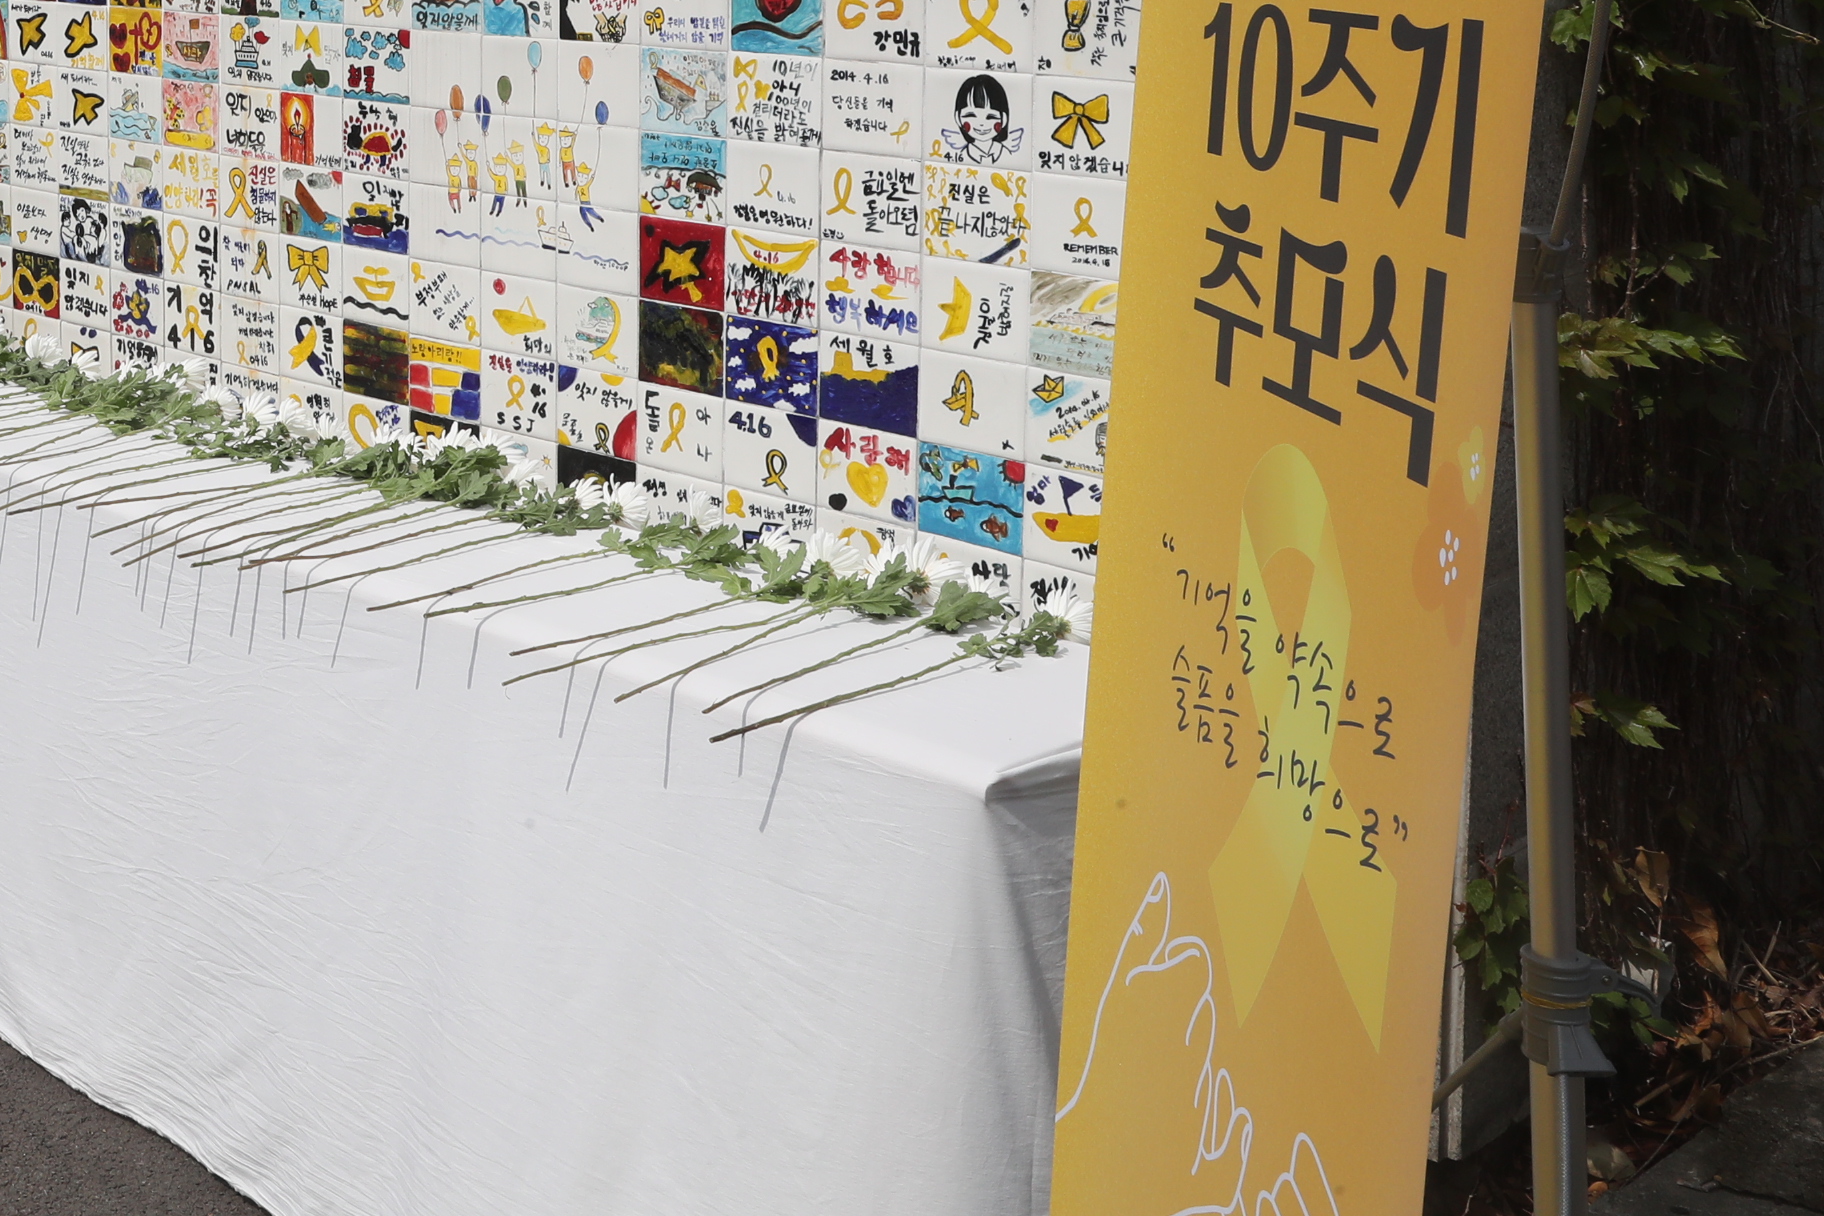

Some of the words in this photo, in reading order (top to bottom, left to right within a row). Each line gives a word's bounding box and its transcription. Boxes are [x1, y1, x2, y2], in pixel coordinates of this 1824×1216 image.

[873, 28, 921, 58] 강민규
[772, 80, 802, 96] 아니
[225, 92, 252, 117] 잊지
[831, 94, 869, 112] 당신들을
[875, 96, 894, 113] 기억
[729, 116, 769, 142] 진실을
[843, 117, 888, 133] 하겠습니다
[1202, 2, 1485, 240] 10주기
[943, 151, 964, 163] 4.16
[1038, 150, 1065, 171] 잊지
[1069, 154, 1129, 176] 않겠습니
[248, 165, 277, 185] 진실은
[861, 167, 921, 202] 금요일엔
[948, 183, 991, 204] 진실은
[862, 200, 920, 237] 돌아오렴
[1063, 242, 1119, 256] REMEMBER
[64, 266, 90, 290] 잊지
[414, 270, 448, 307] 부정부패
[829, 334, 895, 369] 세월호
[1193, 200, 1448, 488] 추모식
[575, 382, 597, 402] 잊지
